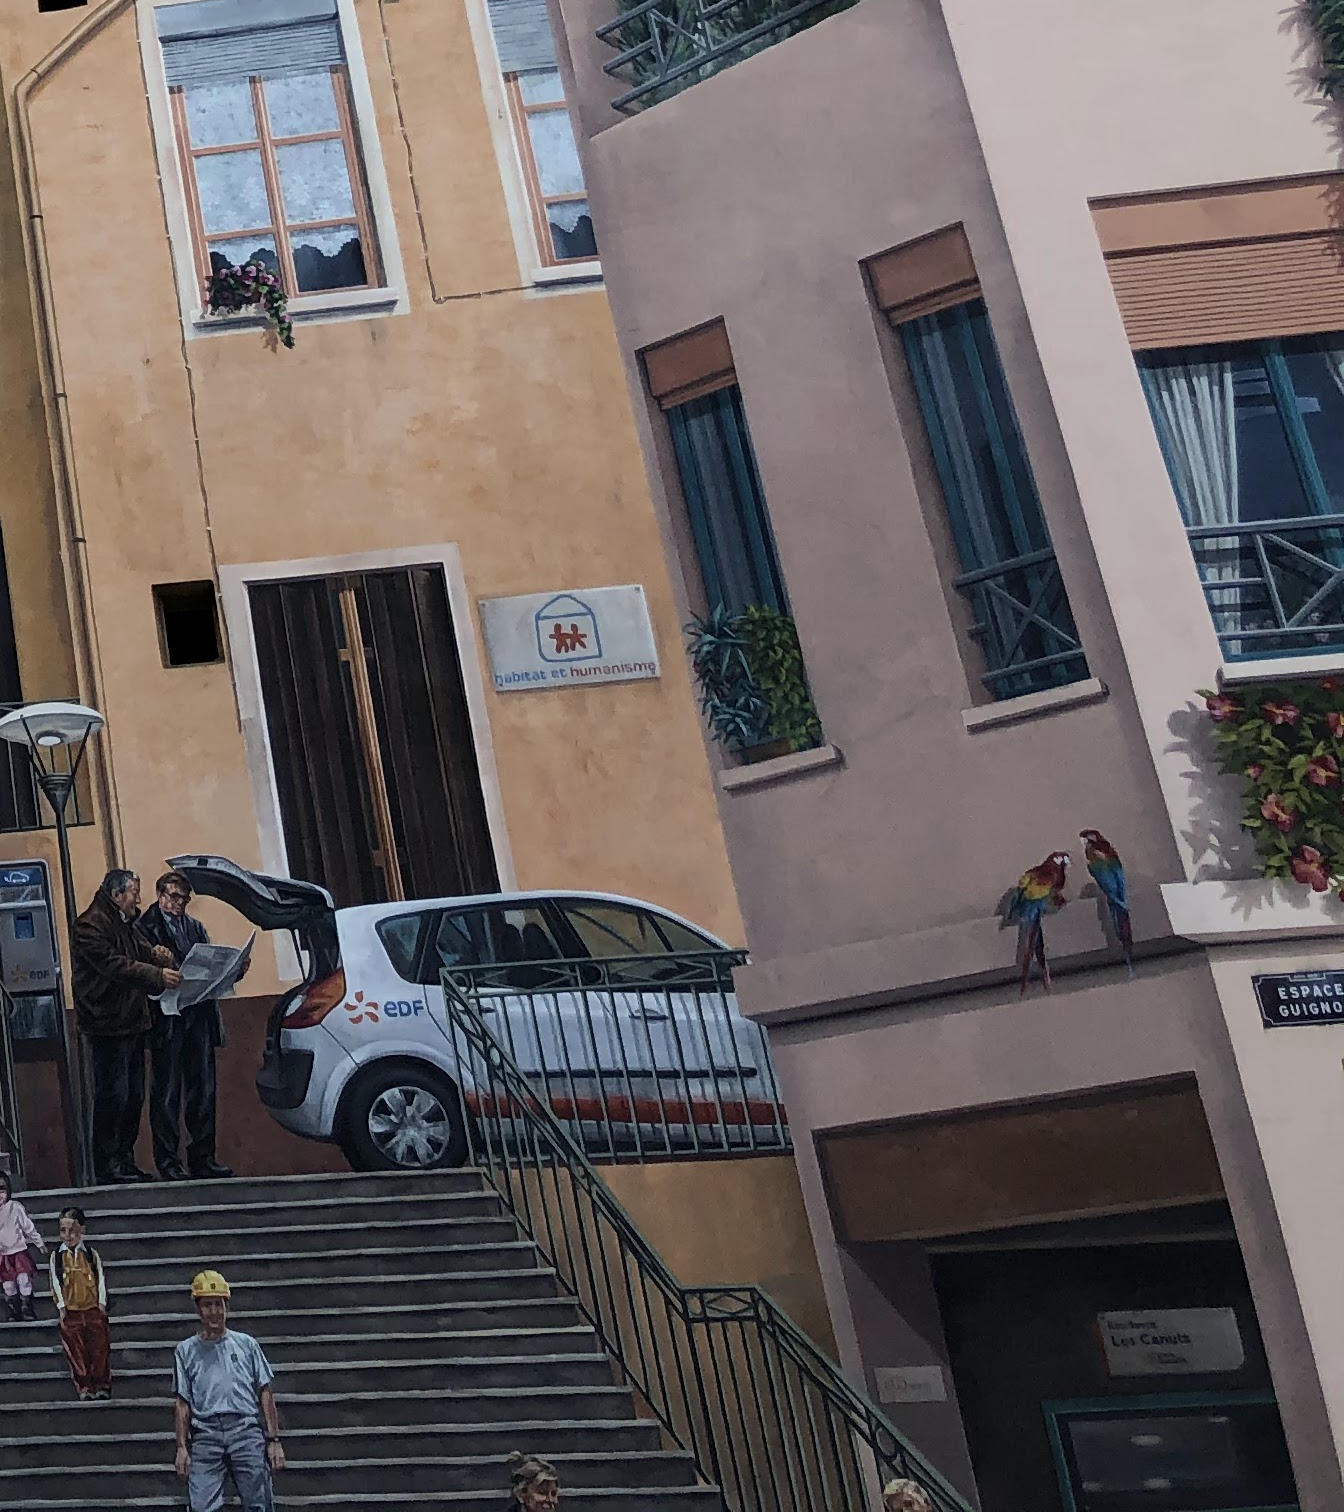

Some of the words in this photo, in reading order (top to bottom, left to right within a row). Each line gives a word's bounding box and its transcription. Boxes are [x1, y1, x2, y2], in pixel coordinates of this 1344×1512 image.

[494, 671, 547, 685] habitat
[550, 668, 567, 679] et
[570, 661, 657, 678] humanisme
[1277, 983, 1344, 1000] ESPACE
